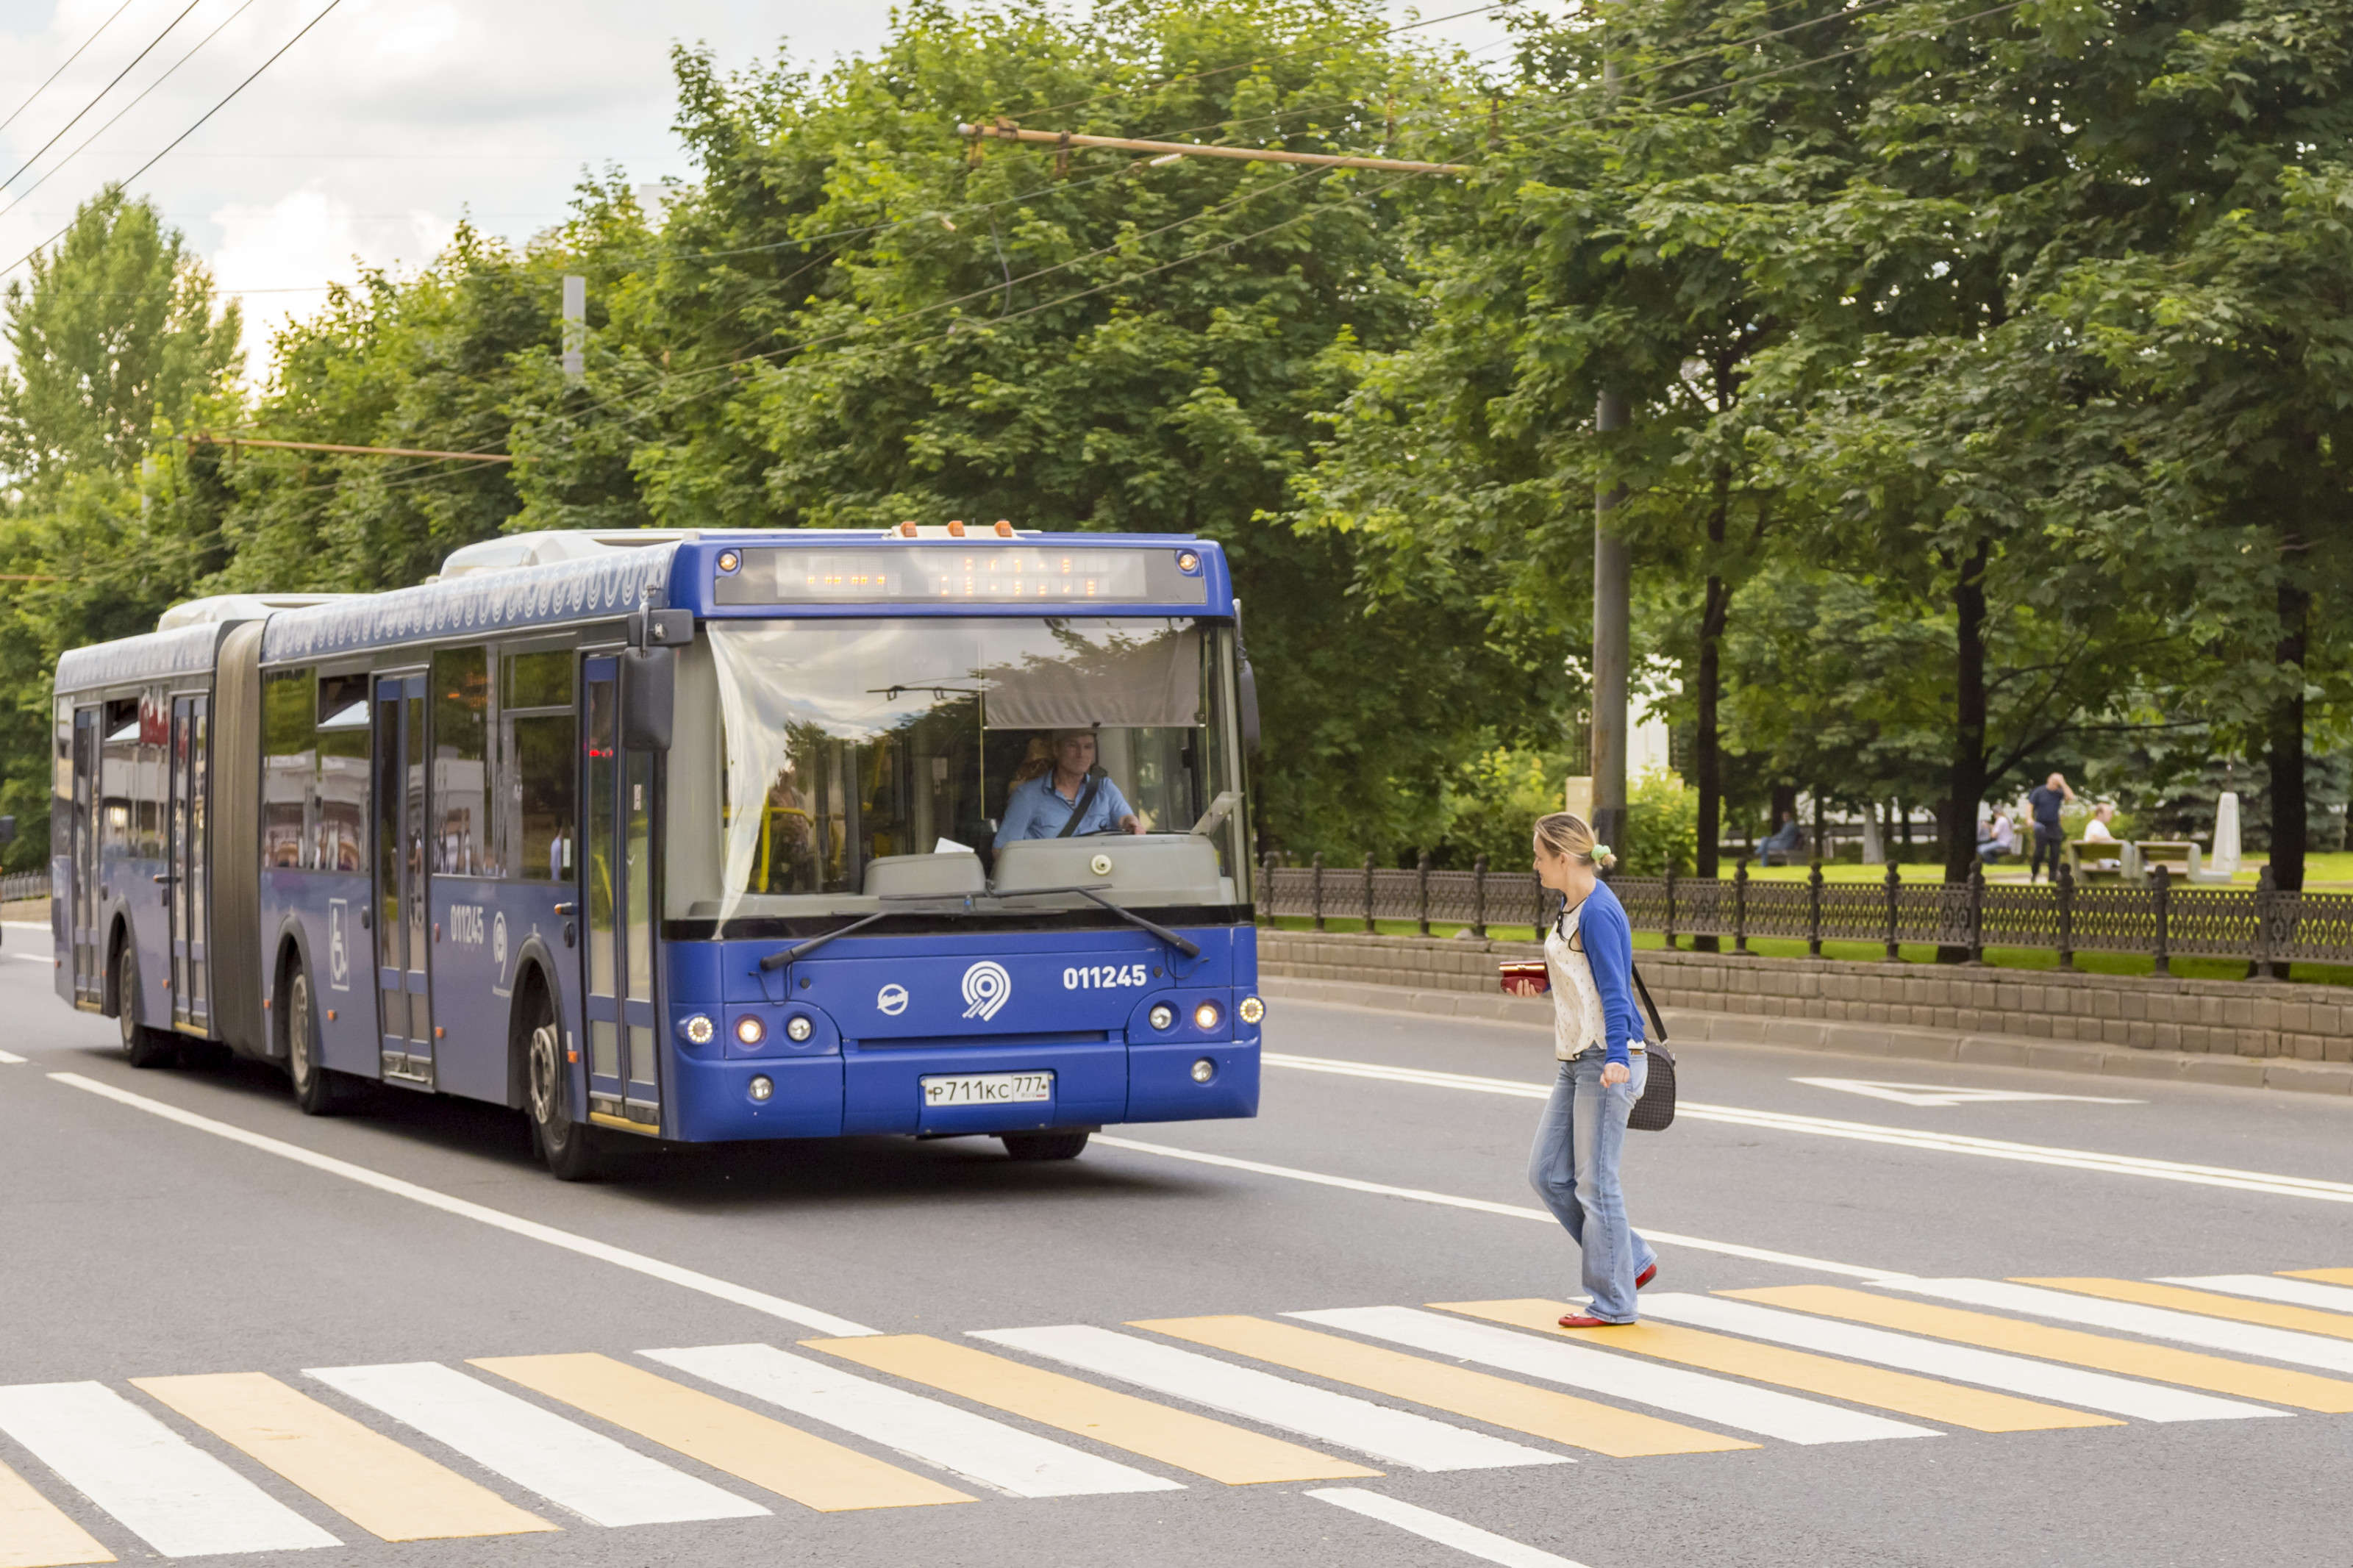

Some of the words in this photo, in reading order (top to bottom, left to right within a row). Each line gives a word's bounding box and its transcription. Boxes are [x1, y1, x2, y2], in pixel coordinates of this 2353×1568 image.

[450, 904, 484, 945] 011245
[1063, 964, 1147, 990] 011245
[1014, 1076, 1042, 1092] 777
